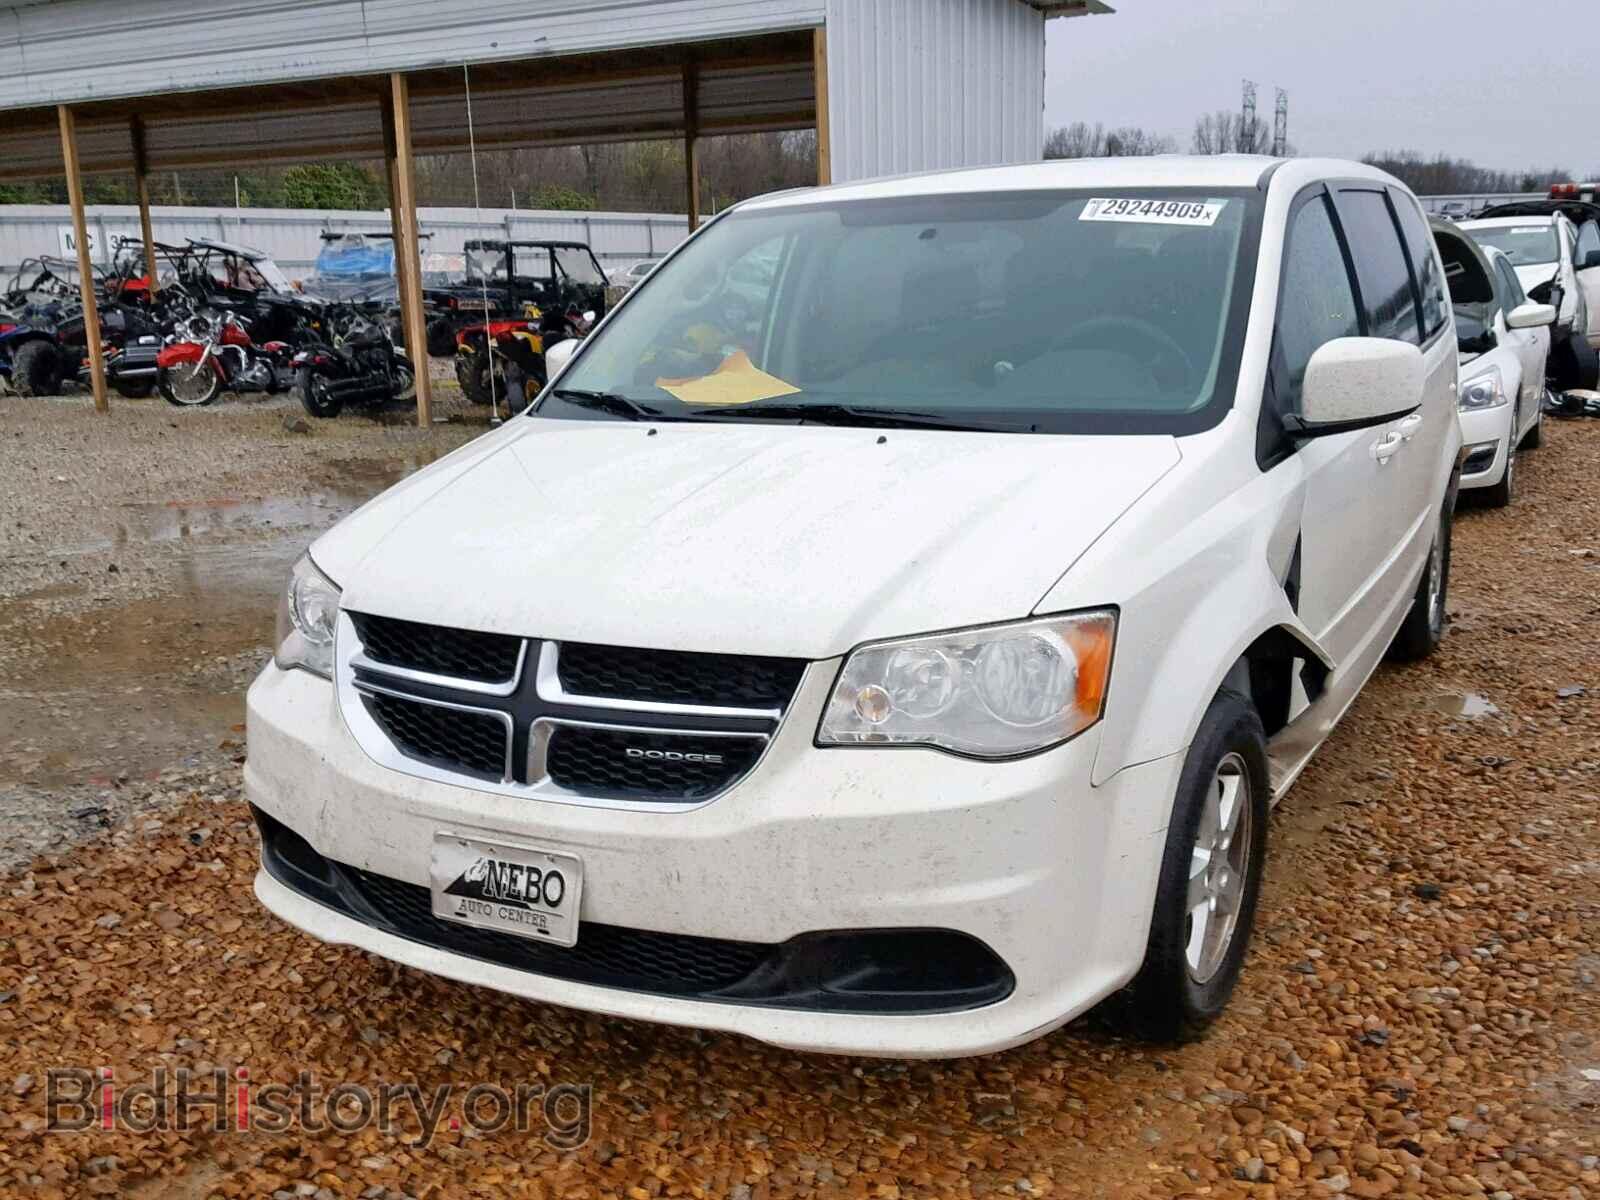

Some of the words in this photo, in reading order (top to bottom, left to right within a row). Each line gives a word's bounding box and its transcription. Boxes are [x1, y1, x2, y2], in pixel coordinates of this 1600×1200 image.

[1101, 199, 1204, 219] 29244909
[625, 748, 723, 763] DODGE
[483, 859, 565, 908] NEBO
[458, 899, 492, 916] AUTO
[498, 906, 547, 928] CENTER
